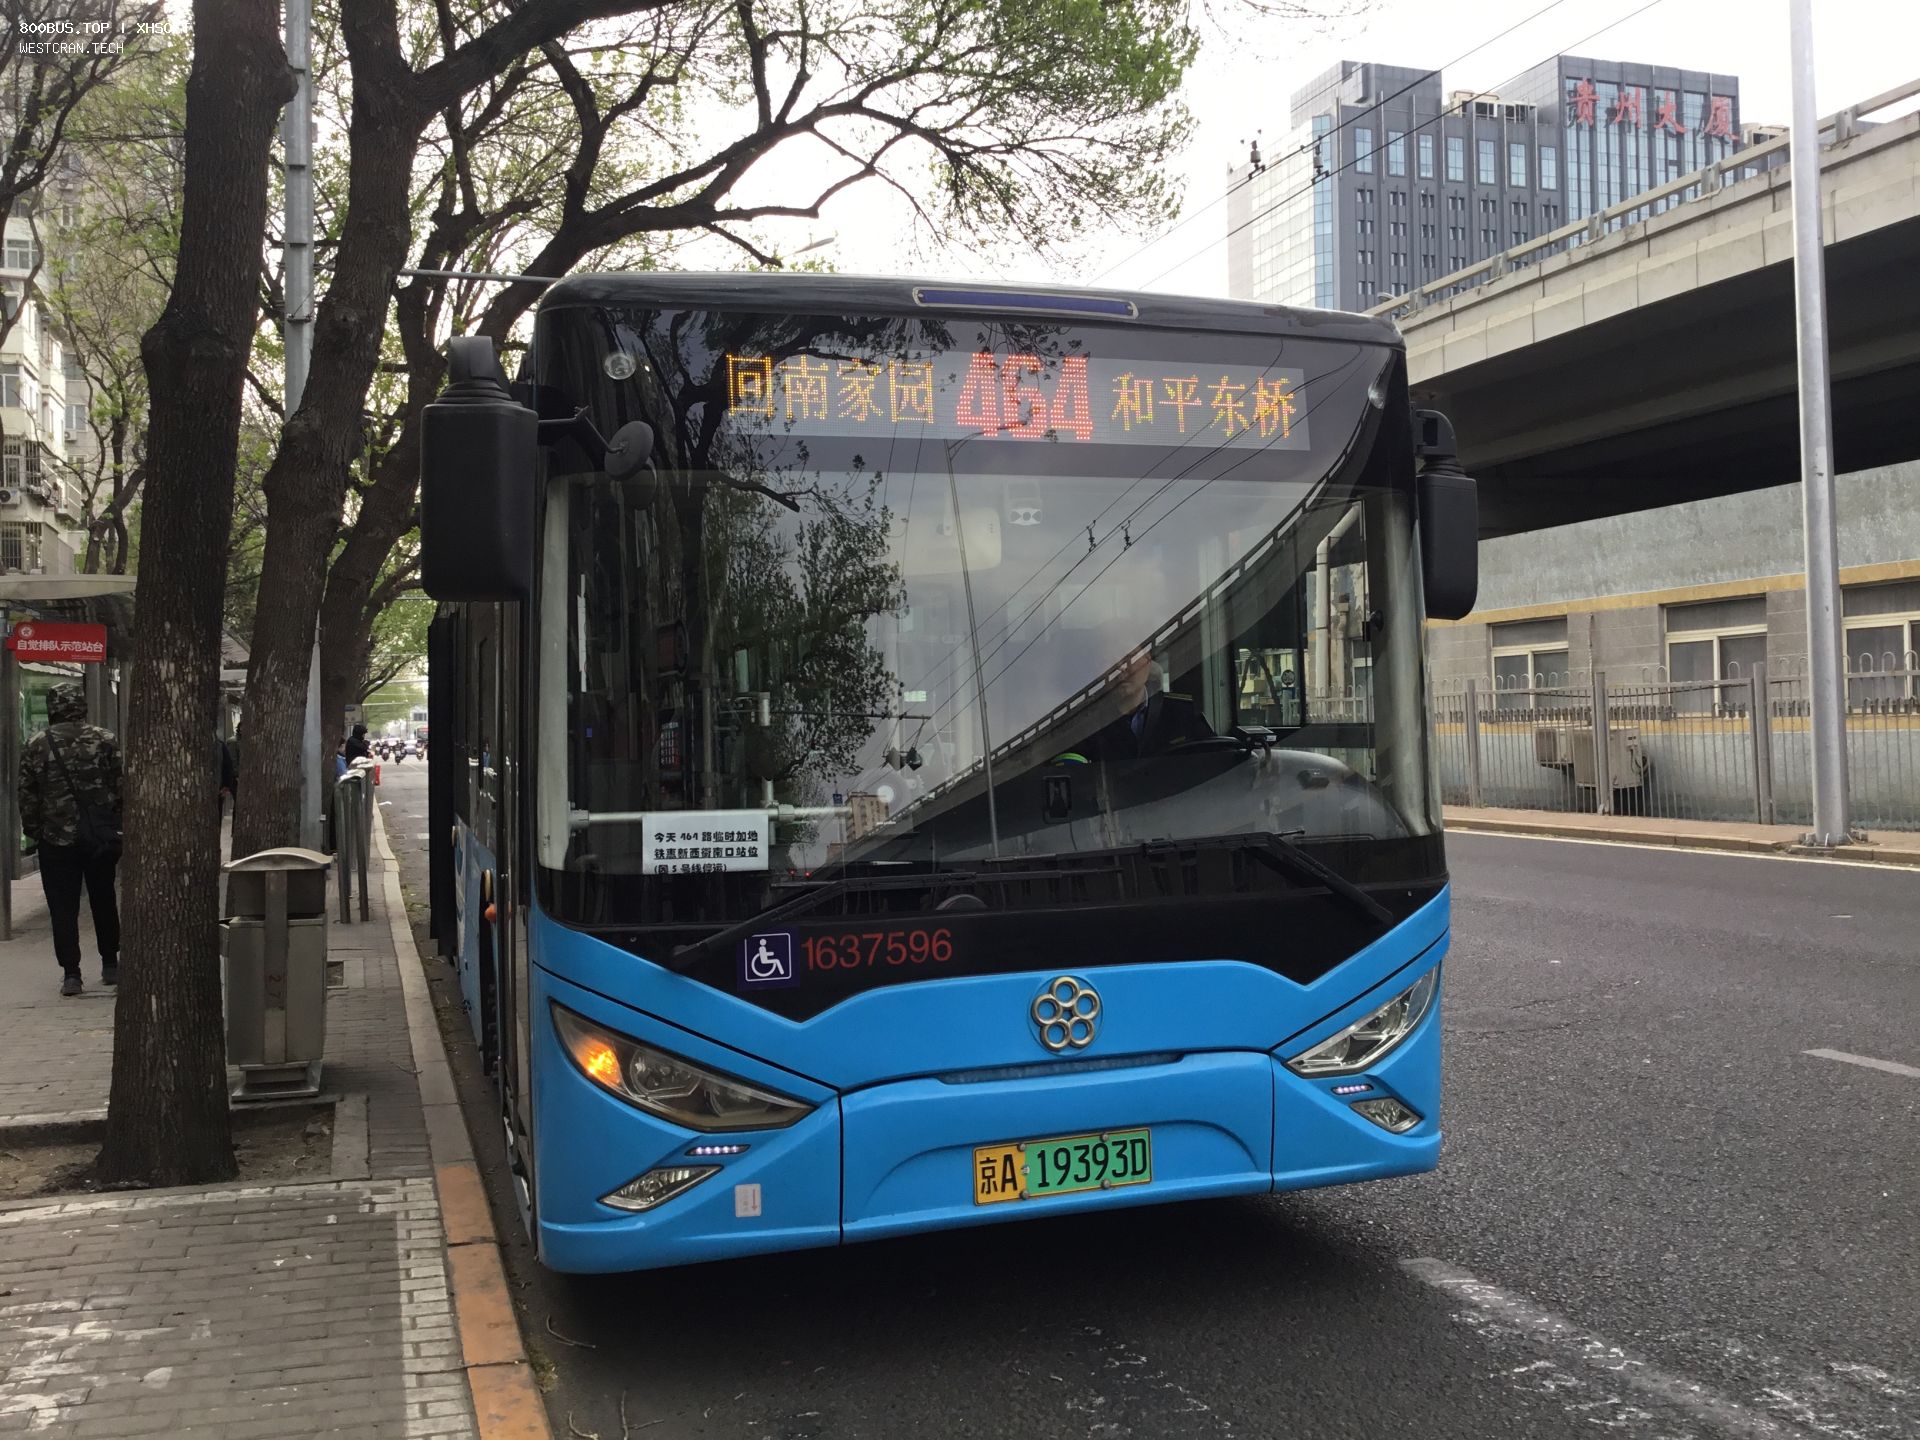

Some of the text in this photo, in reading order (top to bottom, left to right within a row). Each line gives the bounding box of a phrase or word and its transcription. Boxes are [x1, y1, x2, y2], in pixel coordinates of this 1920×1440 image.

[725, 351, 1298, 441] 回南家园 464 和平东桥
[17, 639, 104, 653] 自觉排队示范站台
[654, 832, 677, 843] 今天
[801, 928, 953, 971] 1637596
